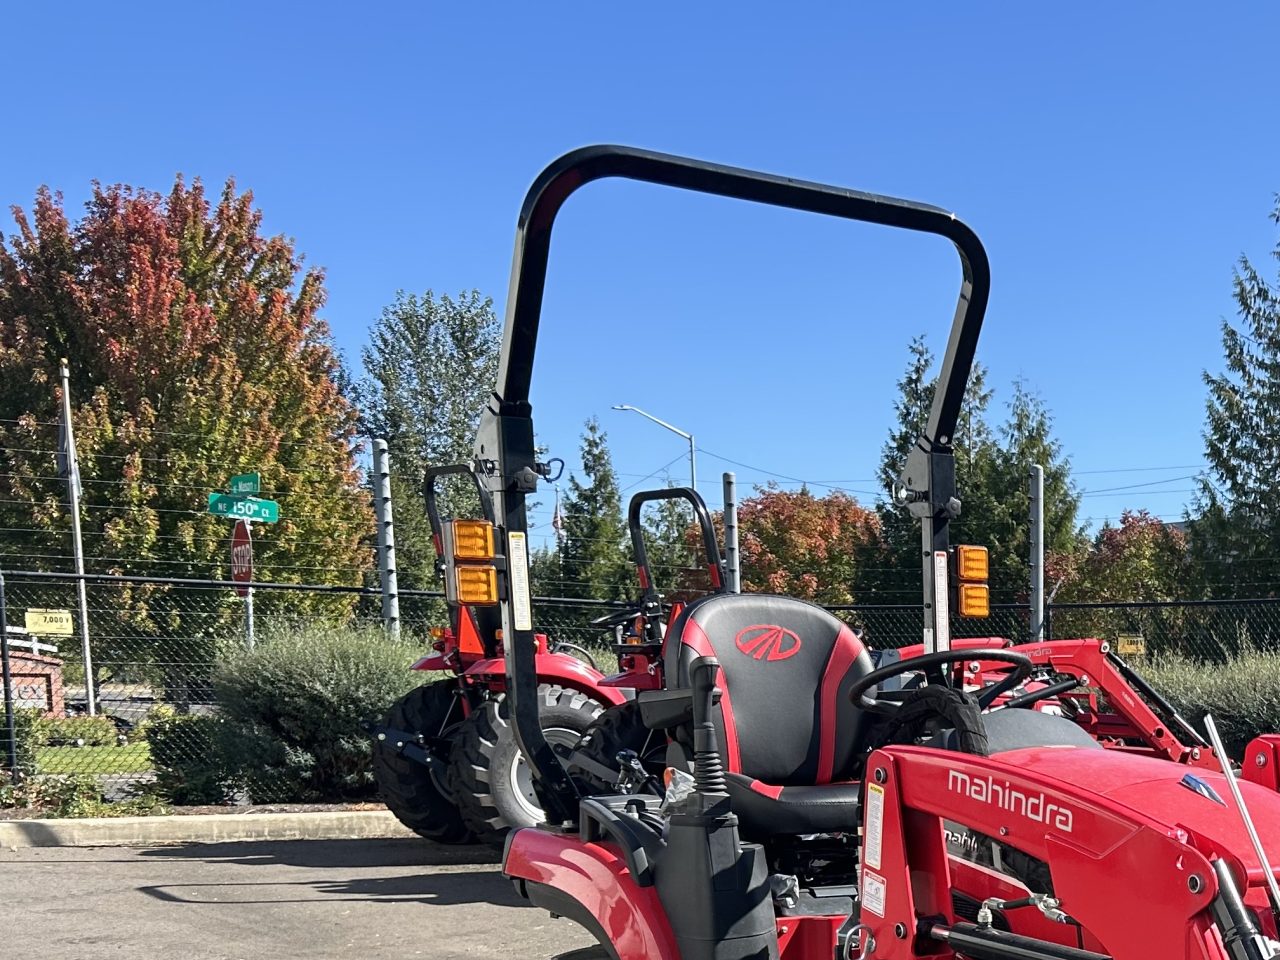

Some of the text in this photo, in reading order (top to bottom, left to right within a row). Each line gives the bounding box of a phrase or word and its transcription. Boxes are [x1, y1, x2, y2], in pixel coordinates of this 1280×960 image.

[217, 502, 227, 512] NE
[233, 543, 250, 575] STOP
[43, 615, 64, 624] 7,000
[948, 769, 1073, 833] mahindra
